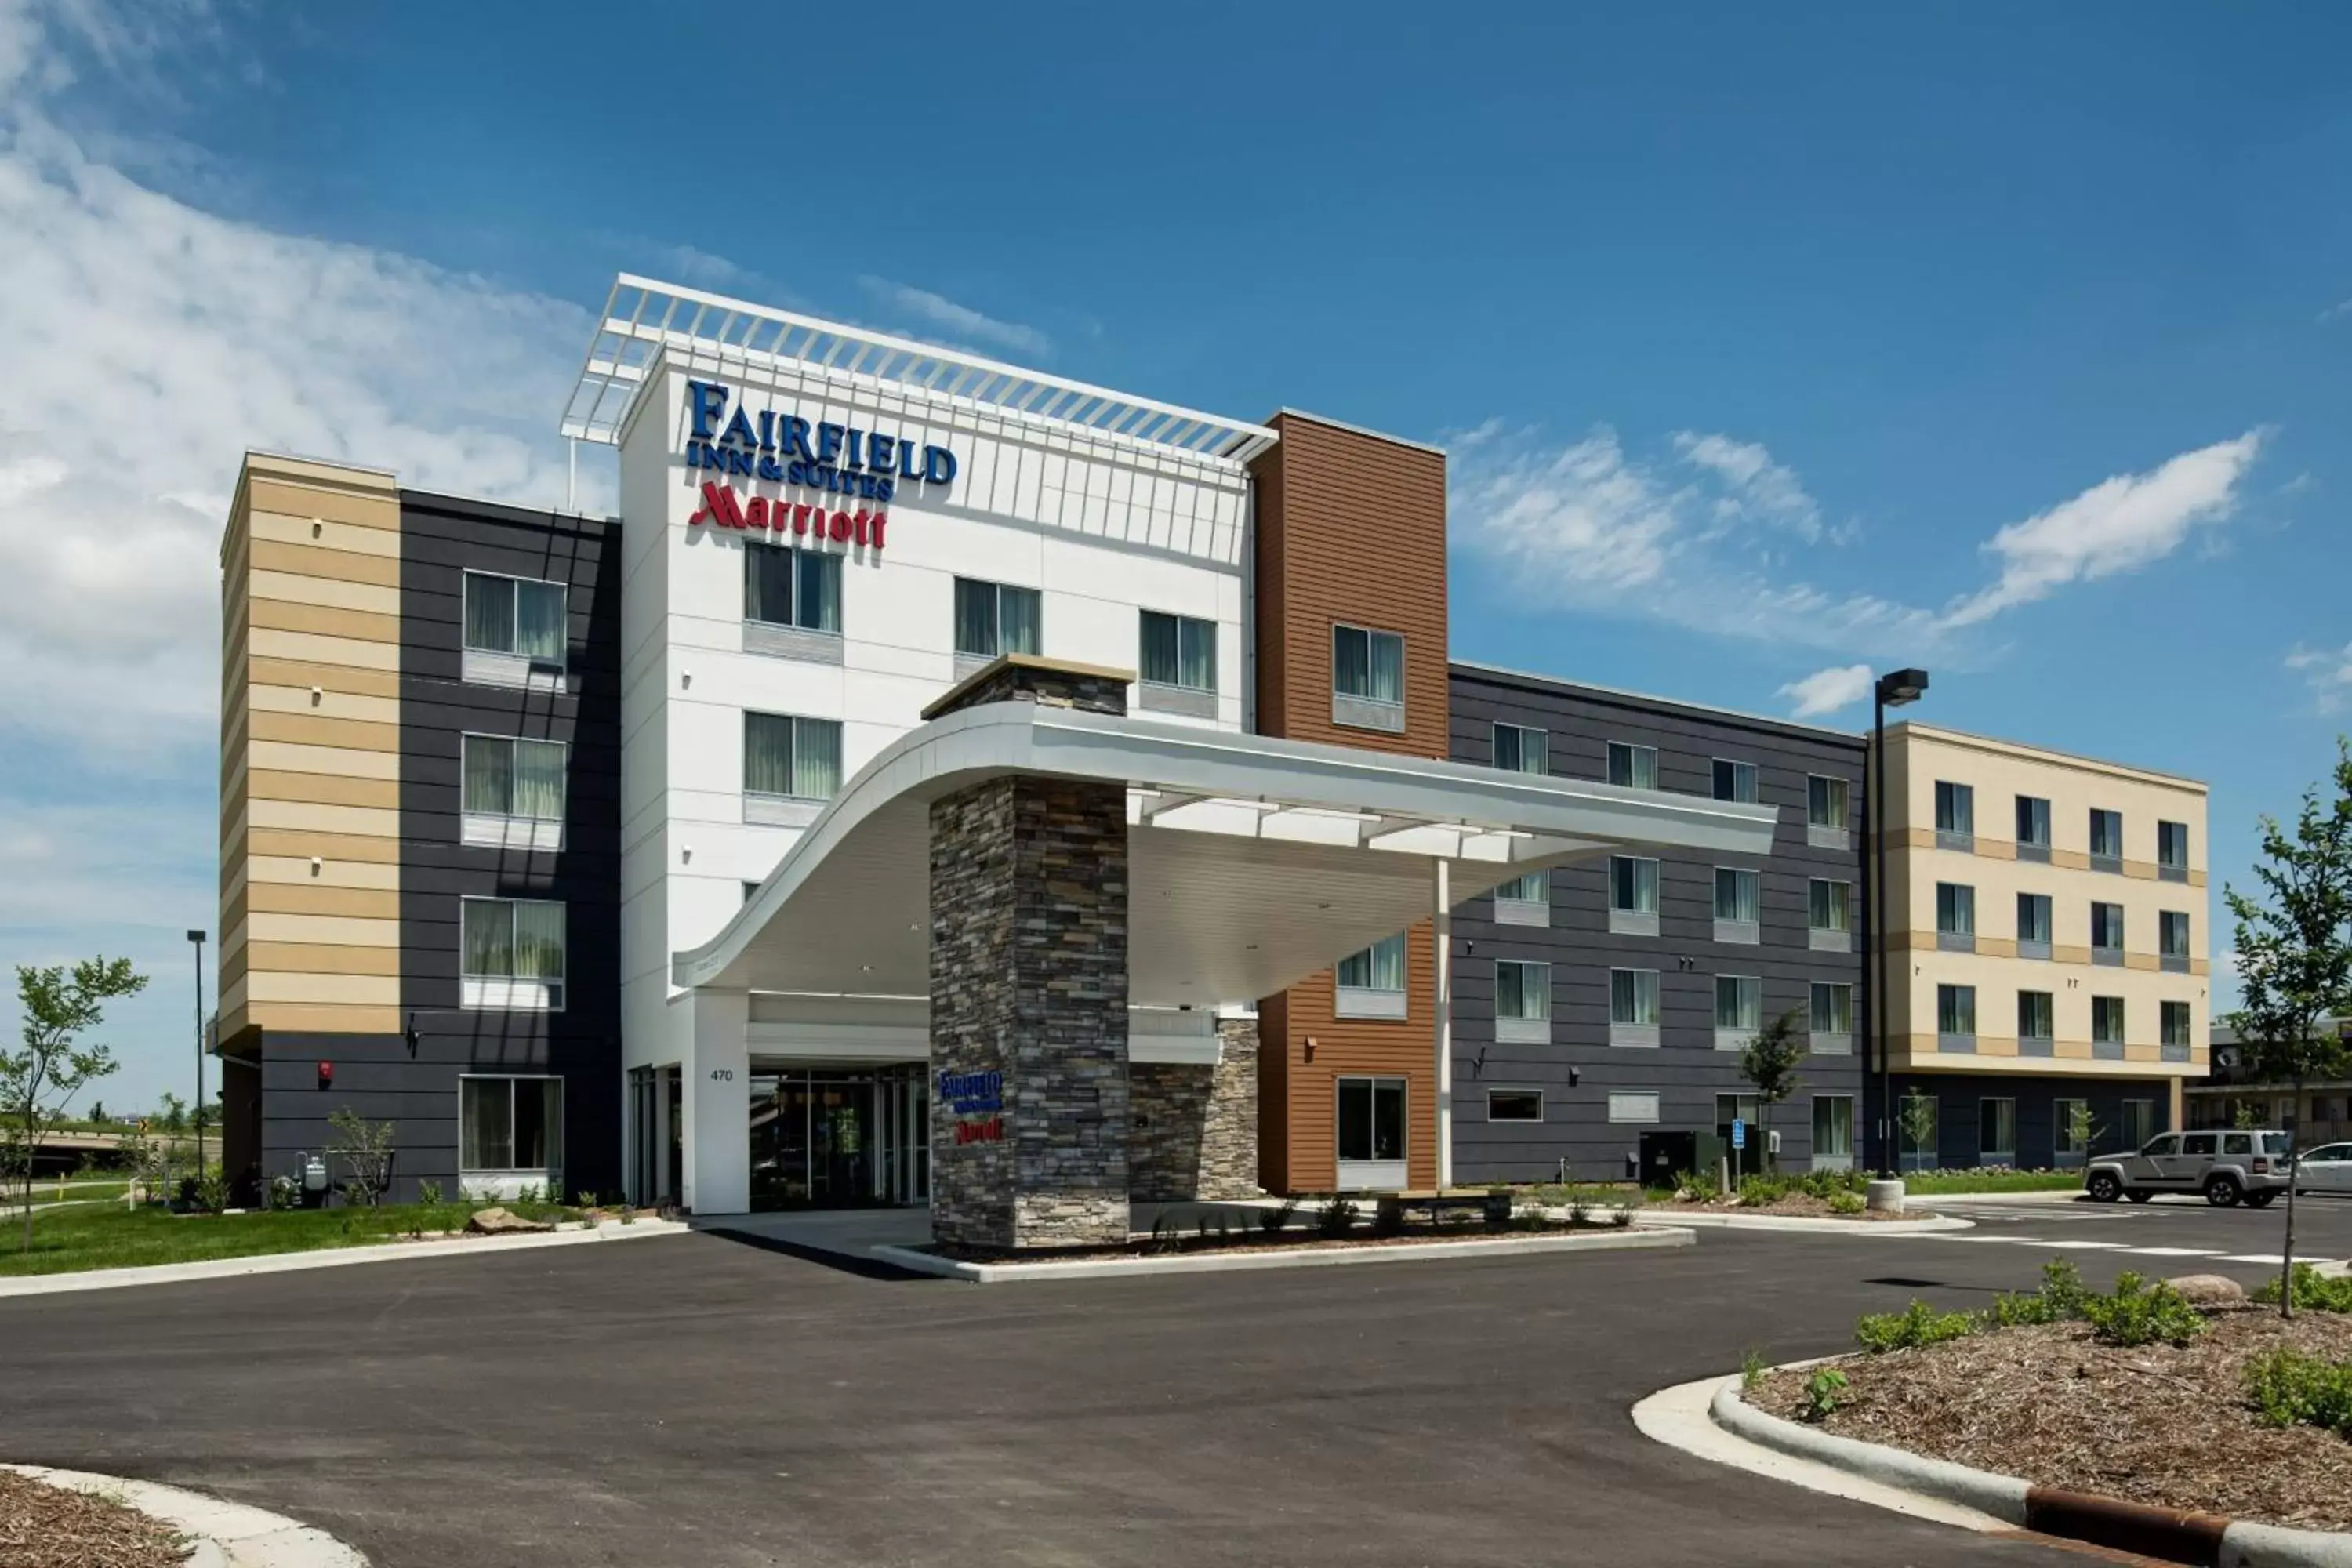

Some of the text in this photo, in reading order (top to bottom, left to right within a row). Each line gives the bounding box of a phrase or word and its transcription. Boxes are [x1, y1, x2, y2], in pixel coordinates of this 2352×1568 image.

[688, 380, 957, 485] FAIRFIELD
[687, 440, 894, 502] INN & SUITES
[688, 481, 887, 549] Marriott
[710, 1069, 733, 1082] 470
